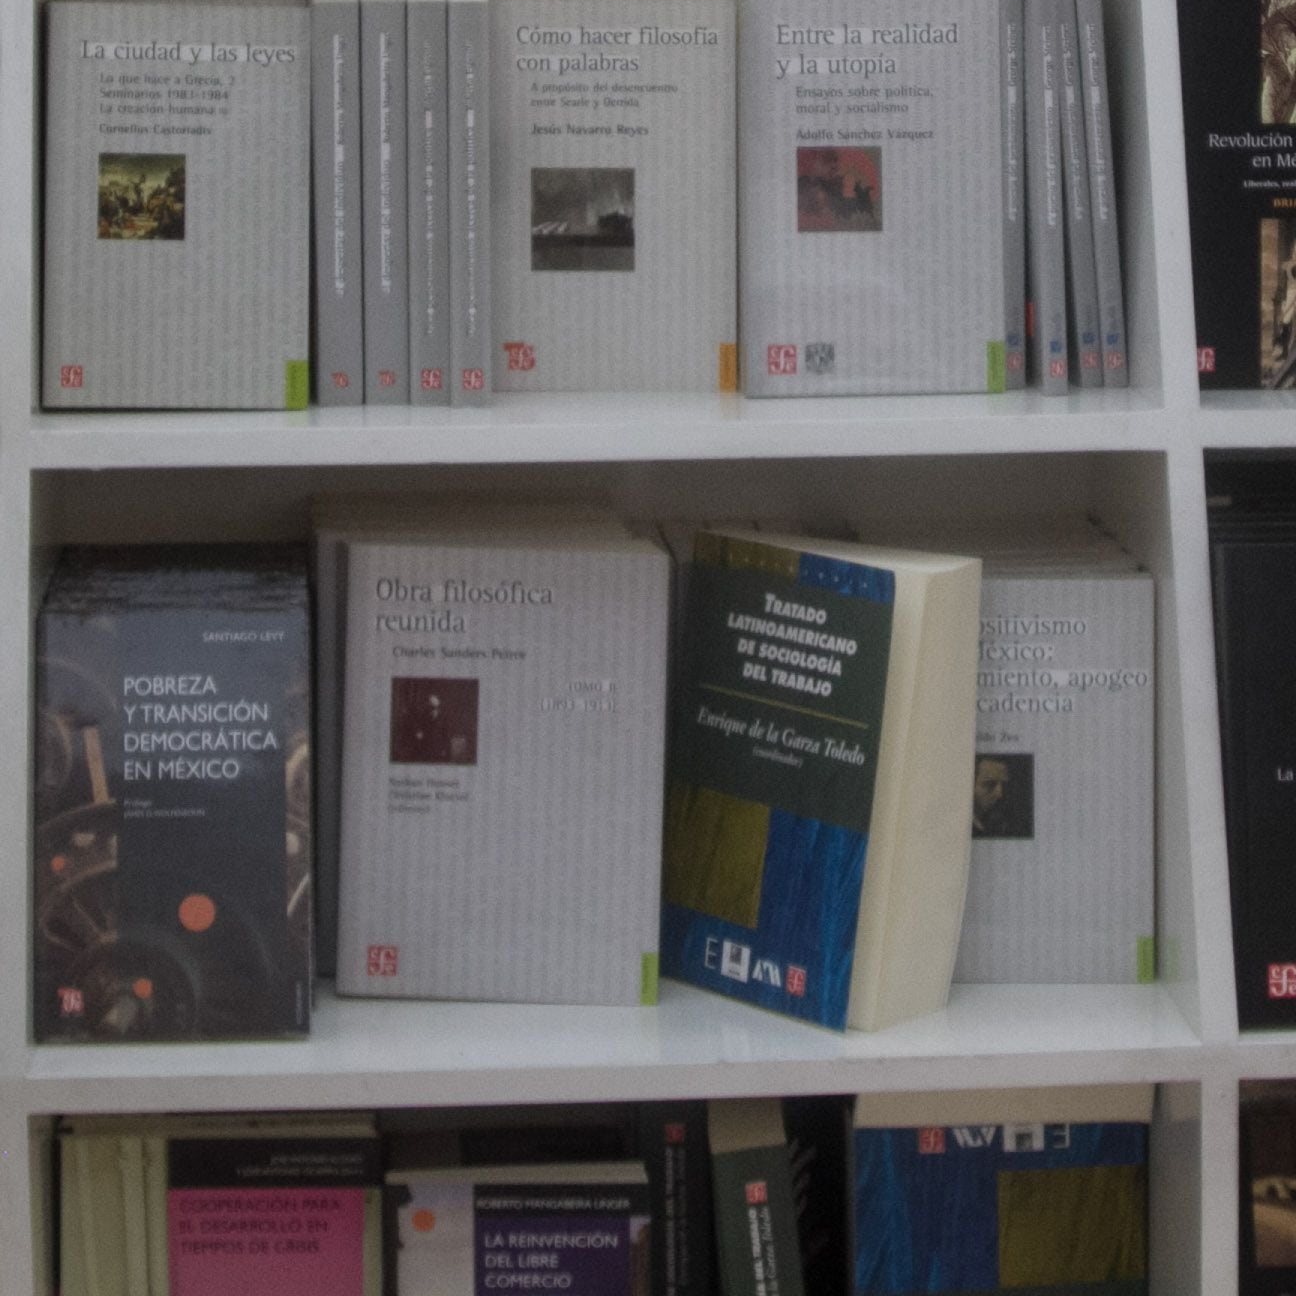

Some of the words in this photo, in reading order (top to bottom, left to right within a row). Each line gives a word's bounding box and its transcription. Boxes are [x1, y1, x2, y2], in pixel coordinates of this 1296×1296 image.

[516, 25, 572, 45] Cómo
[579, 26, 632, 45] hacer
[639, 26, 718, 45] filosofía
[776, 24, 835, 45] Entre
[843, 23, 862, 44] la
[872, 22, 959, 44] realidad
[82, 40, 105, 59] La
[113, 40, 181, 61] ciudad
[188, 48, 203, 66] y
[210, 42, 237, 61] las
[245, 43, 295, 67] leyes
[516, 57, 551, 71] con
[558, 53, 640, 76] palabras
[776, 58, 791, 80] y
[798, 53, 818, 75] la
[827, 52, 896, 79] utopía
[795, 86, 843, 100] Ensayos
[848, 86, 880, 98] sobre
[795, 102, 830, 114] moral
[847, 102, 909, 114] socialismo
[796, 128, 834, 140] Adolfo
[1208, 132, 1293, 148] Revolución
[1252, 154, 1272, 167] en
[375, 577, 433, 603] Obra
[443, 578, 554, 606] filosófica
[765, 592, 828, 625] TRATADO
[375, 609, 466, 633] reunida
[202, 631, 258, 642] SANTIAGO
[727, 612, 858, 656] LATINOAMERICANO
[737, 637, 756, 656] DE
[758, 643, 842, 677] SOCIOLOGÍA
[979, 640, 1053, 662] éxico:
[123, 675, 218, 696] POBREZA
[742, 661, 767, 681] DEL
[770, 668, 833, 697] TRABAJO
[976, 665, 1058, 689] miento,
[1067, 669, 1148, 693] apogeo
[123, 705, 137, 724] Y
[140, 697, 270, 724] TRANSICIÓN
[976, 692, 1073, 714] cadencia
[123, 727, 279, 752] DEMOCRÁTICA
[697, 706, 747, 737] Enrique
[748, 718, 765, 739] de
[766, 723, 779, 744] la
[781, 727, 821, 754] Garza
[823, 736, 866, 765] Toledo
[123, 761, 151, 781] EN
[158, 756, 240, 780] MÉXICO
[1277, 767, 1293, 782] La
[484, 1233, 504, 1248] LA
[508, 1230, 619, 1249] REINVENCIÓN
[484, 1253, 513, 1269] DEL
[517, 1253, 559, 1269] LIBRE
[484, 1273, 572, 1290] COMERCIO
